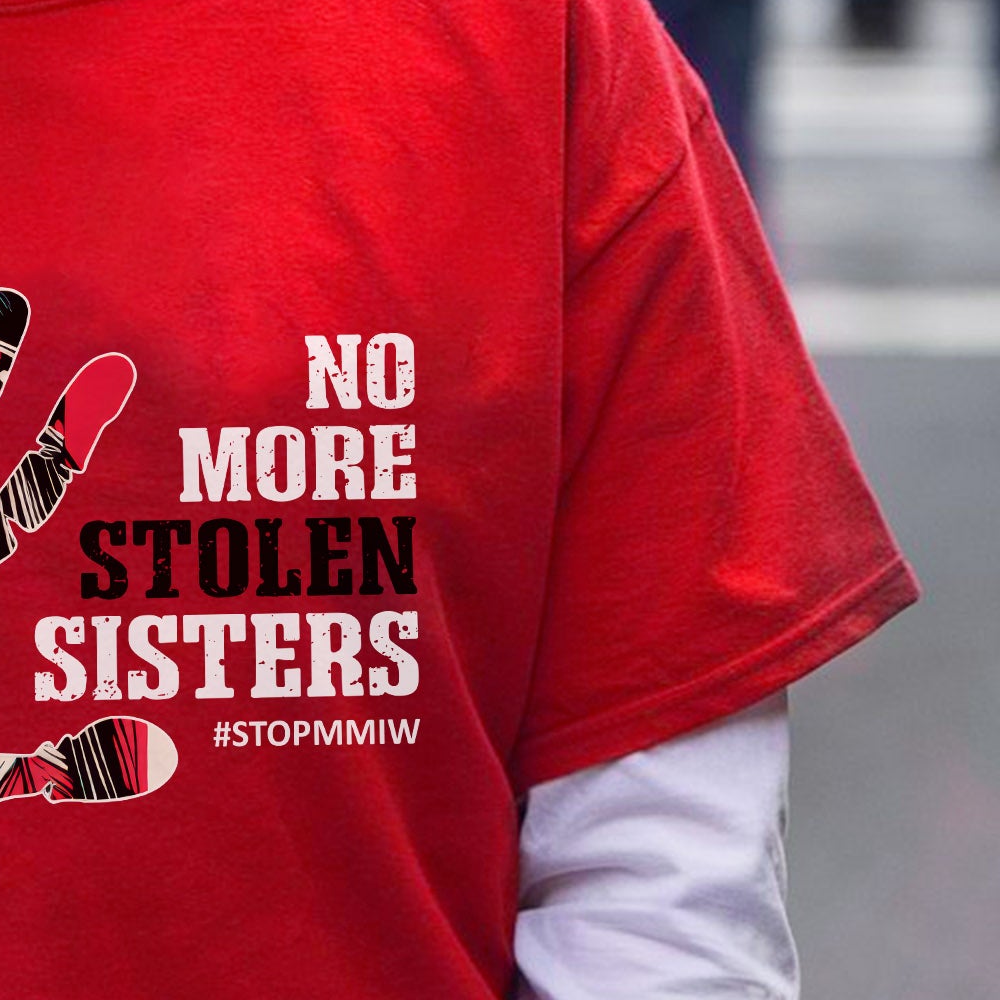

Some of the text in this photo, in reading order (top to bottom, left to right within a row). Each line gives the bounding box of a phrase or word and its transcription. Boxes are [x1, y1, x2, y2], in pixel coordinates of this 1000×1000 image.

[304, 332, 416, 410] NO
[178, 424, 418, 503] MORE
[79, 516, 419, 600] STOLEN
[33, 610, 420, 702] SISTERS
[213, 718, 421, 748] #STOPMMIW
